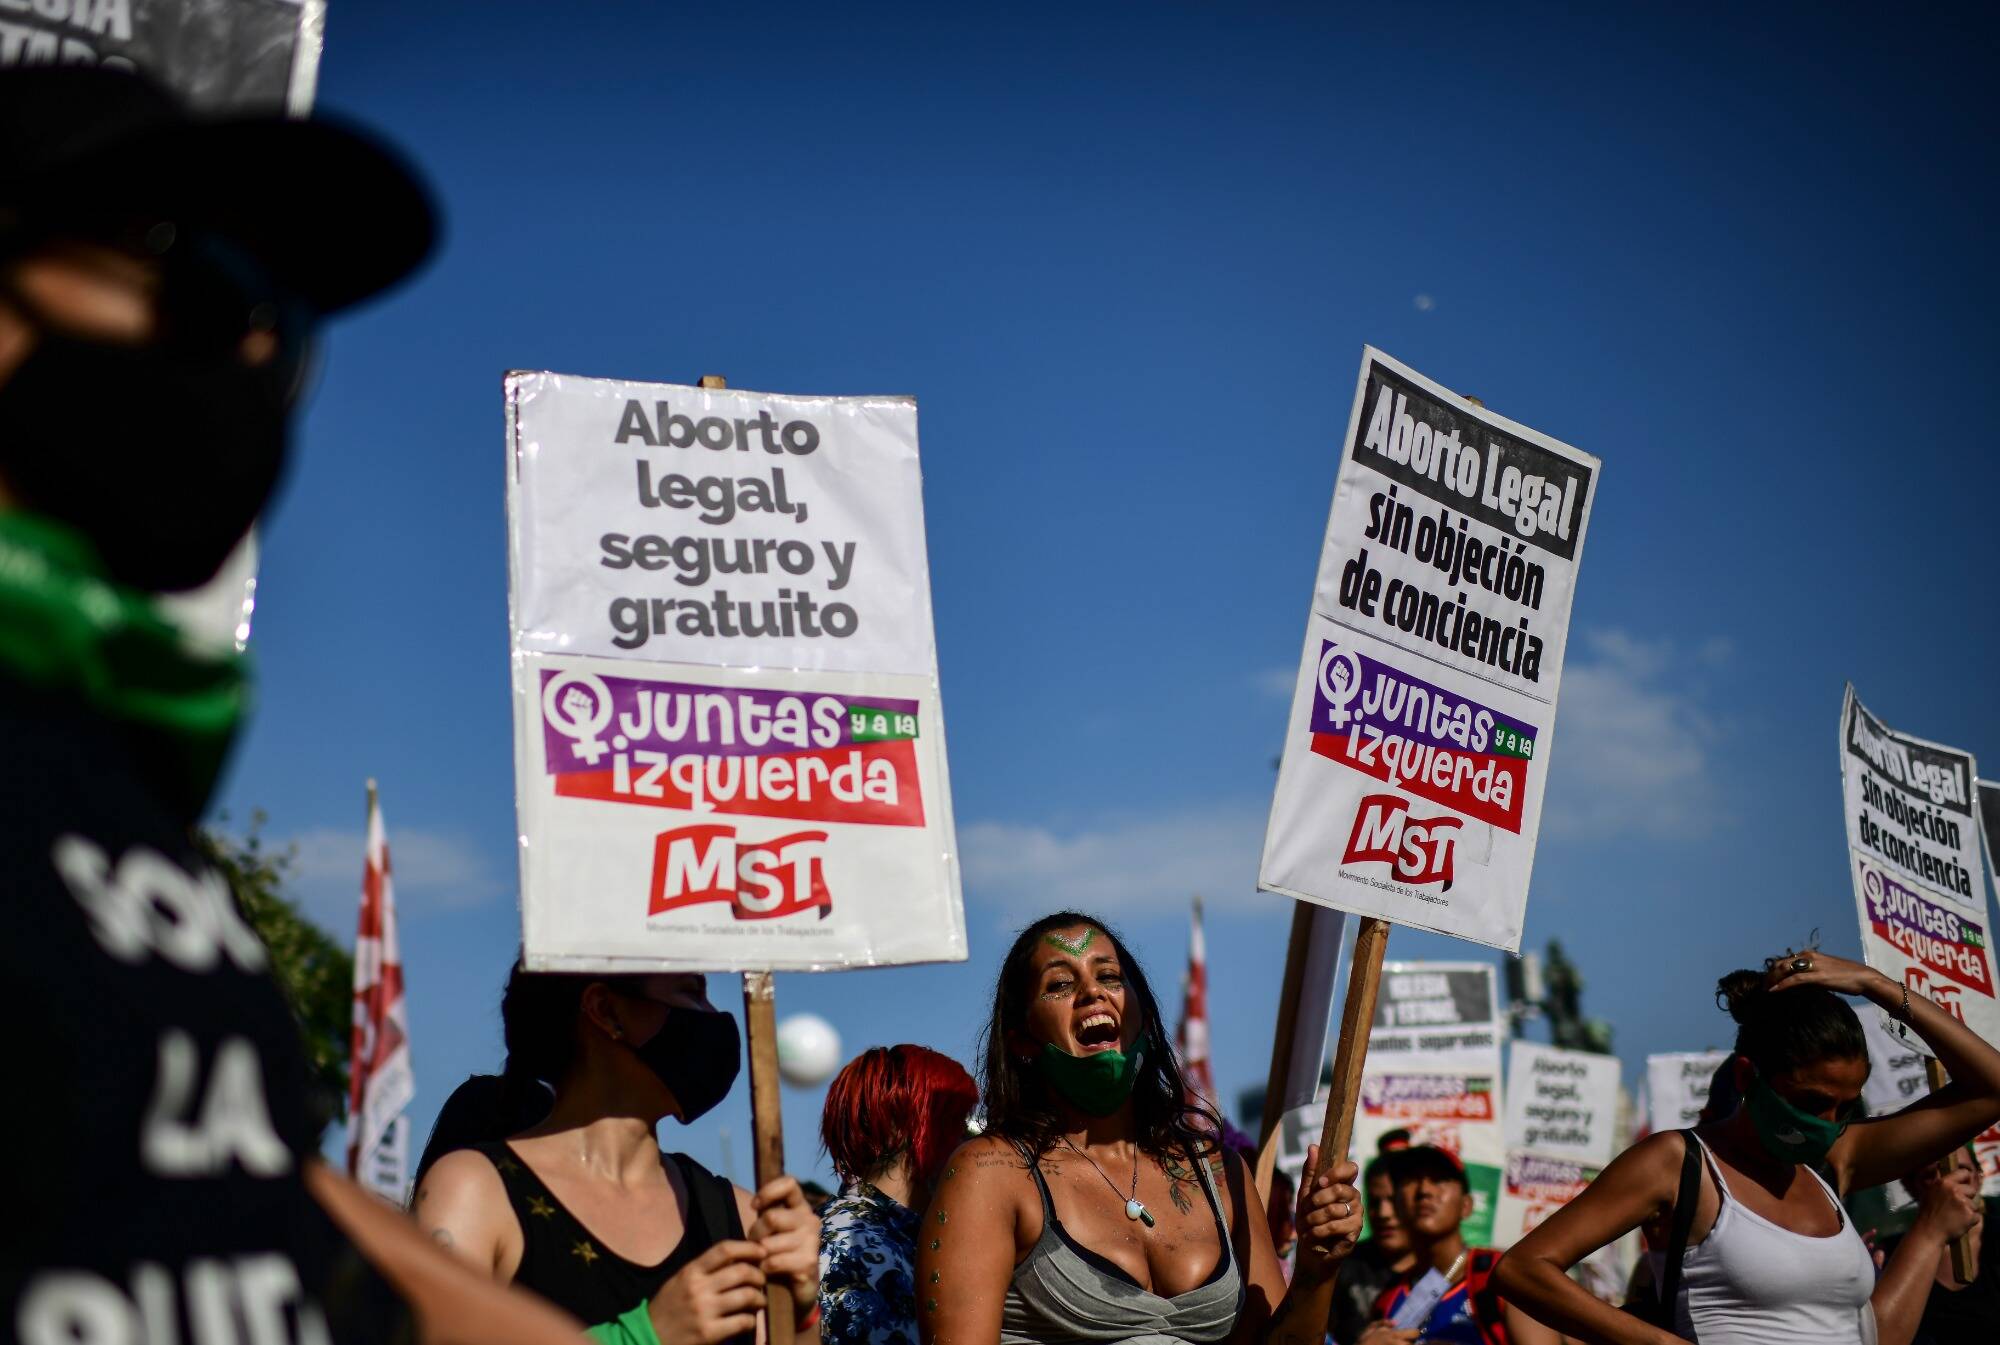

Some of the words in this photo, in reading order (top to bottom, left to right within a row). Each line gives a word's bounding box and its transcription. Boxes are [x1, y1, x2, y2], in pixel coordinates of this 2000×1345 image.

[614, 399, 820, 456] Aborto
[1364, 385, 1480, 498] Aborto
[1481, 443, 1579, 540] Legal
[637, 459, 808, 524] legal,
[600, 532, 815, 587] seguro
[821, 541, 857, 590] y
[1364, 484, 1414, 554] sin
[1414, 510, 1545, 611] objeción
[608, 588, 859, 649] gratuito
[1339, 548, 1382, 618] de
[1382, 577, 1544, 684] conciencia
[851, 714, 866, 734] y
[872, 715, 888, 735] a
[895, 714, 917, 736] la
[1346, 708, 1514, 811] izquierda
[1494, 729, 1504, 746] y
[1506, 734, 1516, 750] a
[1852, 705, 1903, 782] Aborto
[1901, 746, 1967, 805] Legal
[612, 734, 898, 812] izquierda
[1861, 768, 1884, 814] sin
[1884, 787, 1961, 851] objeción
[664, 837, 827, 913] MST
[1354, 804, 1463, 877] MST
[1859, 808, 1880, 852] de
[1881, 826, 1973, 899] conciencia
[1338, 869, 1368, 885] Movimiento
[1370, 877, 1395, 892] Socialista
[1396, 886, 1404, 895] de
[1415, 890, 1449, 907] Trabajadores
[140, 1032, 292, 1177] LA
